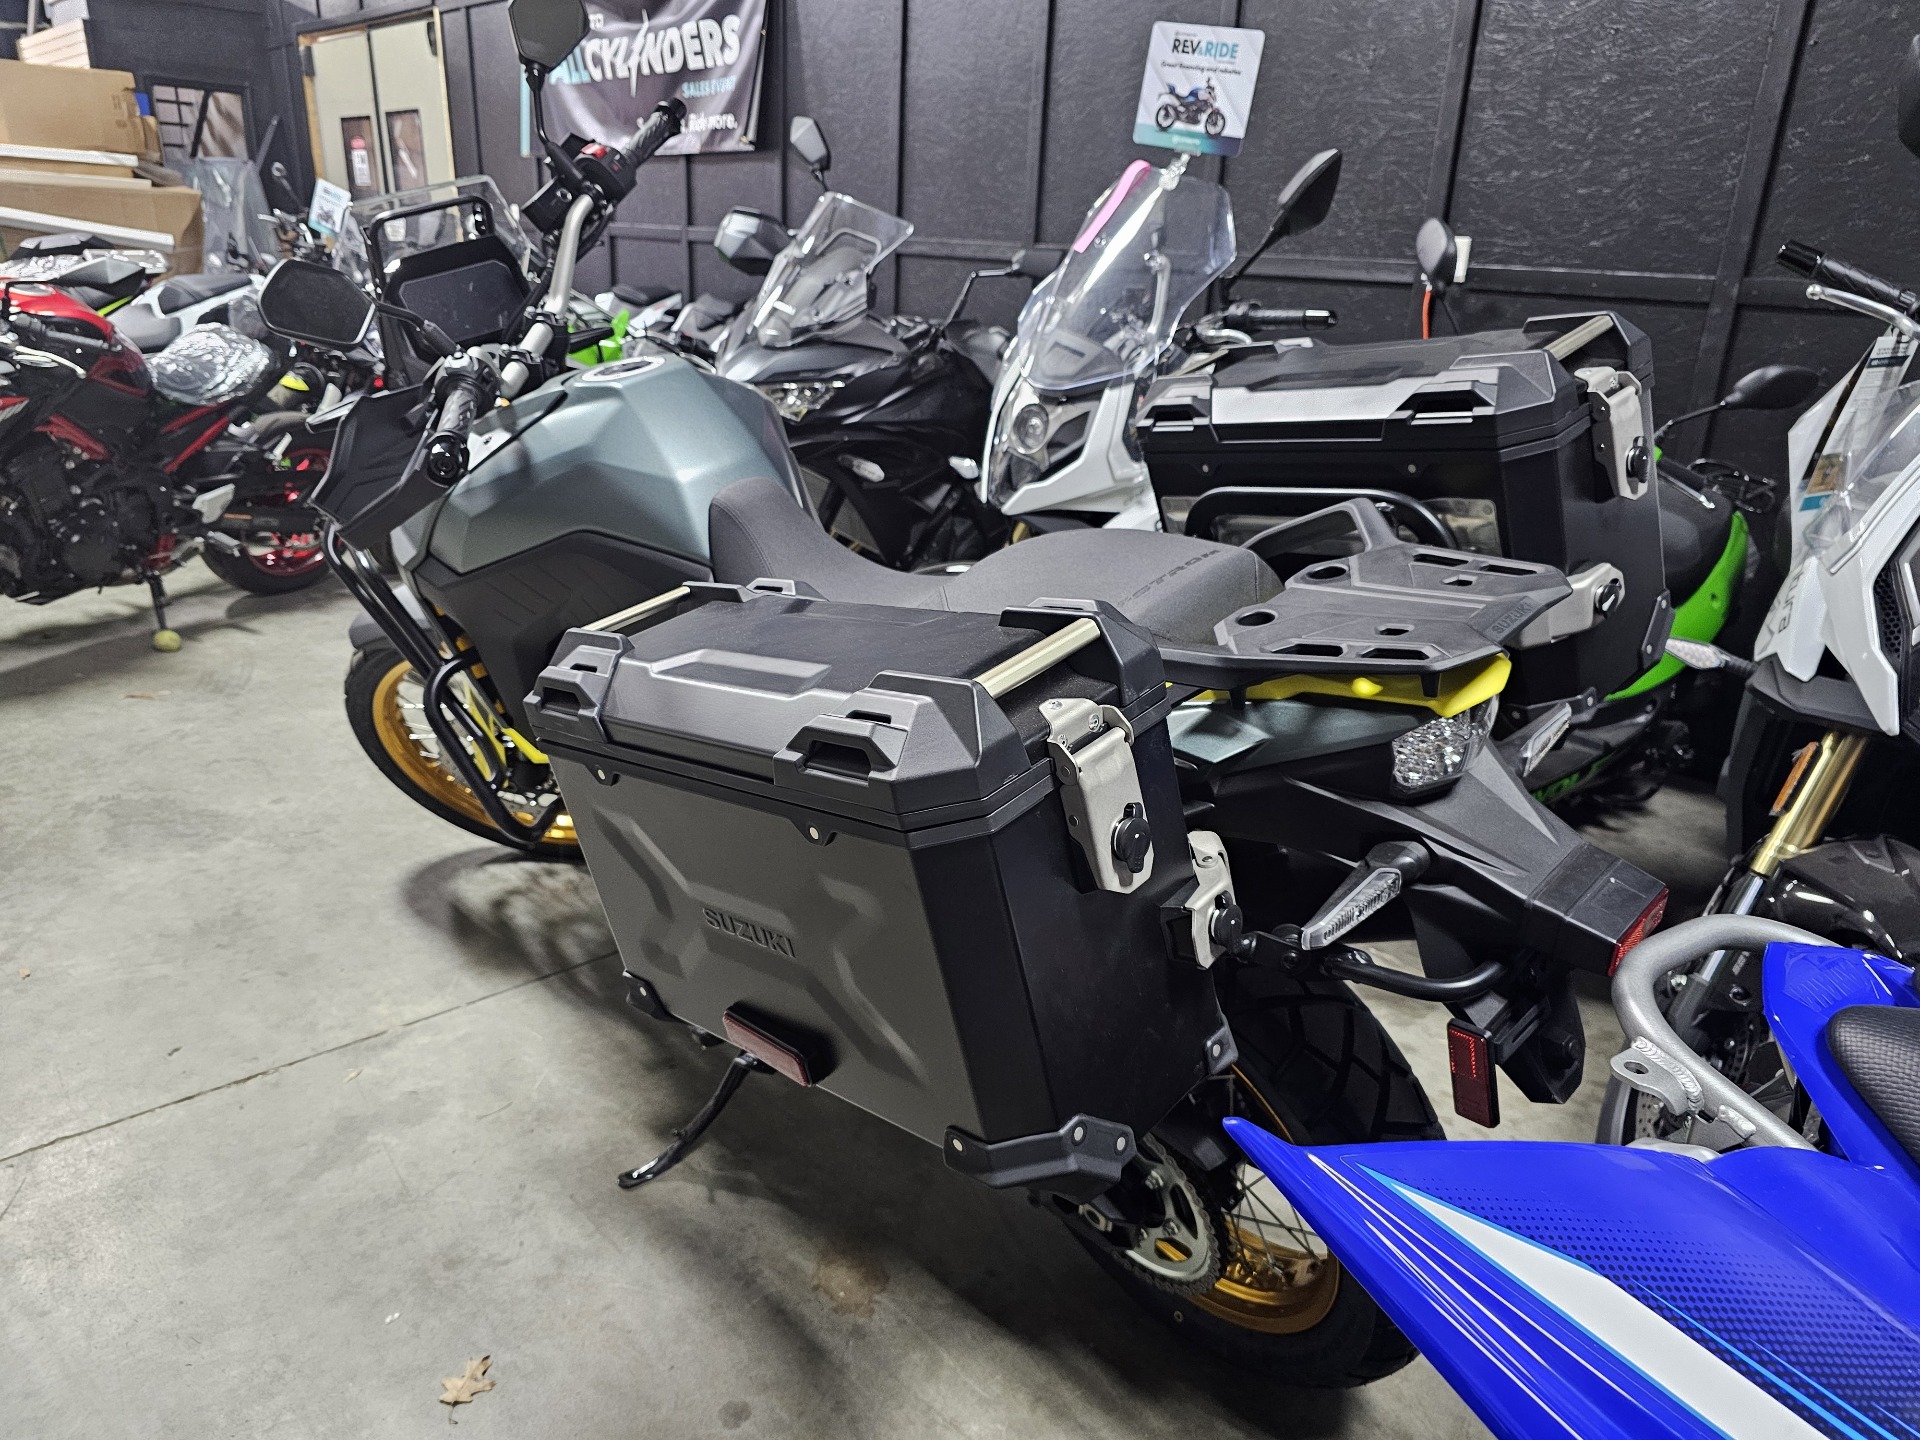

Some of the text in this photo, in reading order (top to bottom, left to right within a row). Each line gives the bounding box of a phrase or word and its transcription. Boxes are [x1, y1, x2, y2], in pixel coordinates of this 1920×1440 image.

[585, 10, 741, 97] CYLINDERS
[1491, 601, 1535, 634] SUZUKI
[702, 907, 797, 959] SUZUKI
